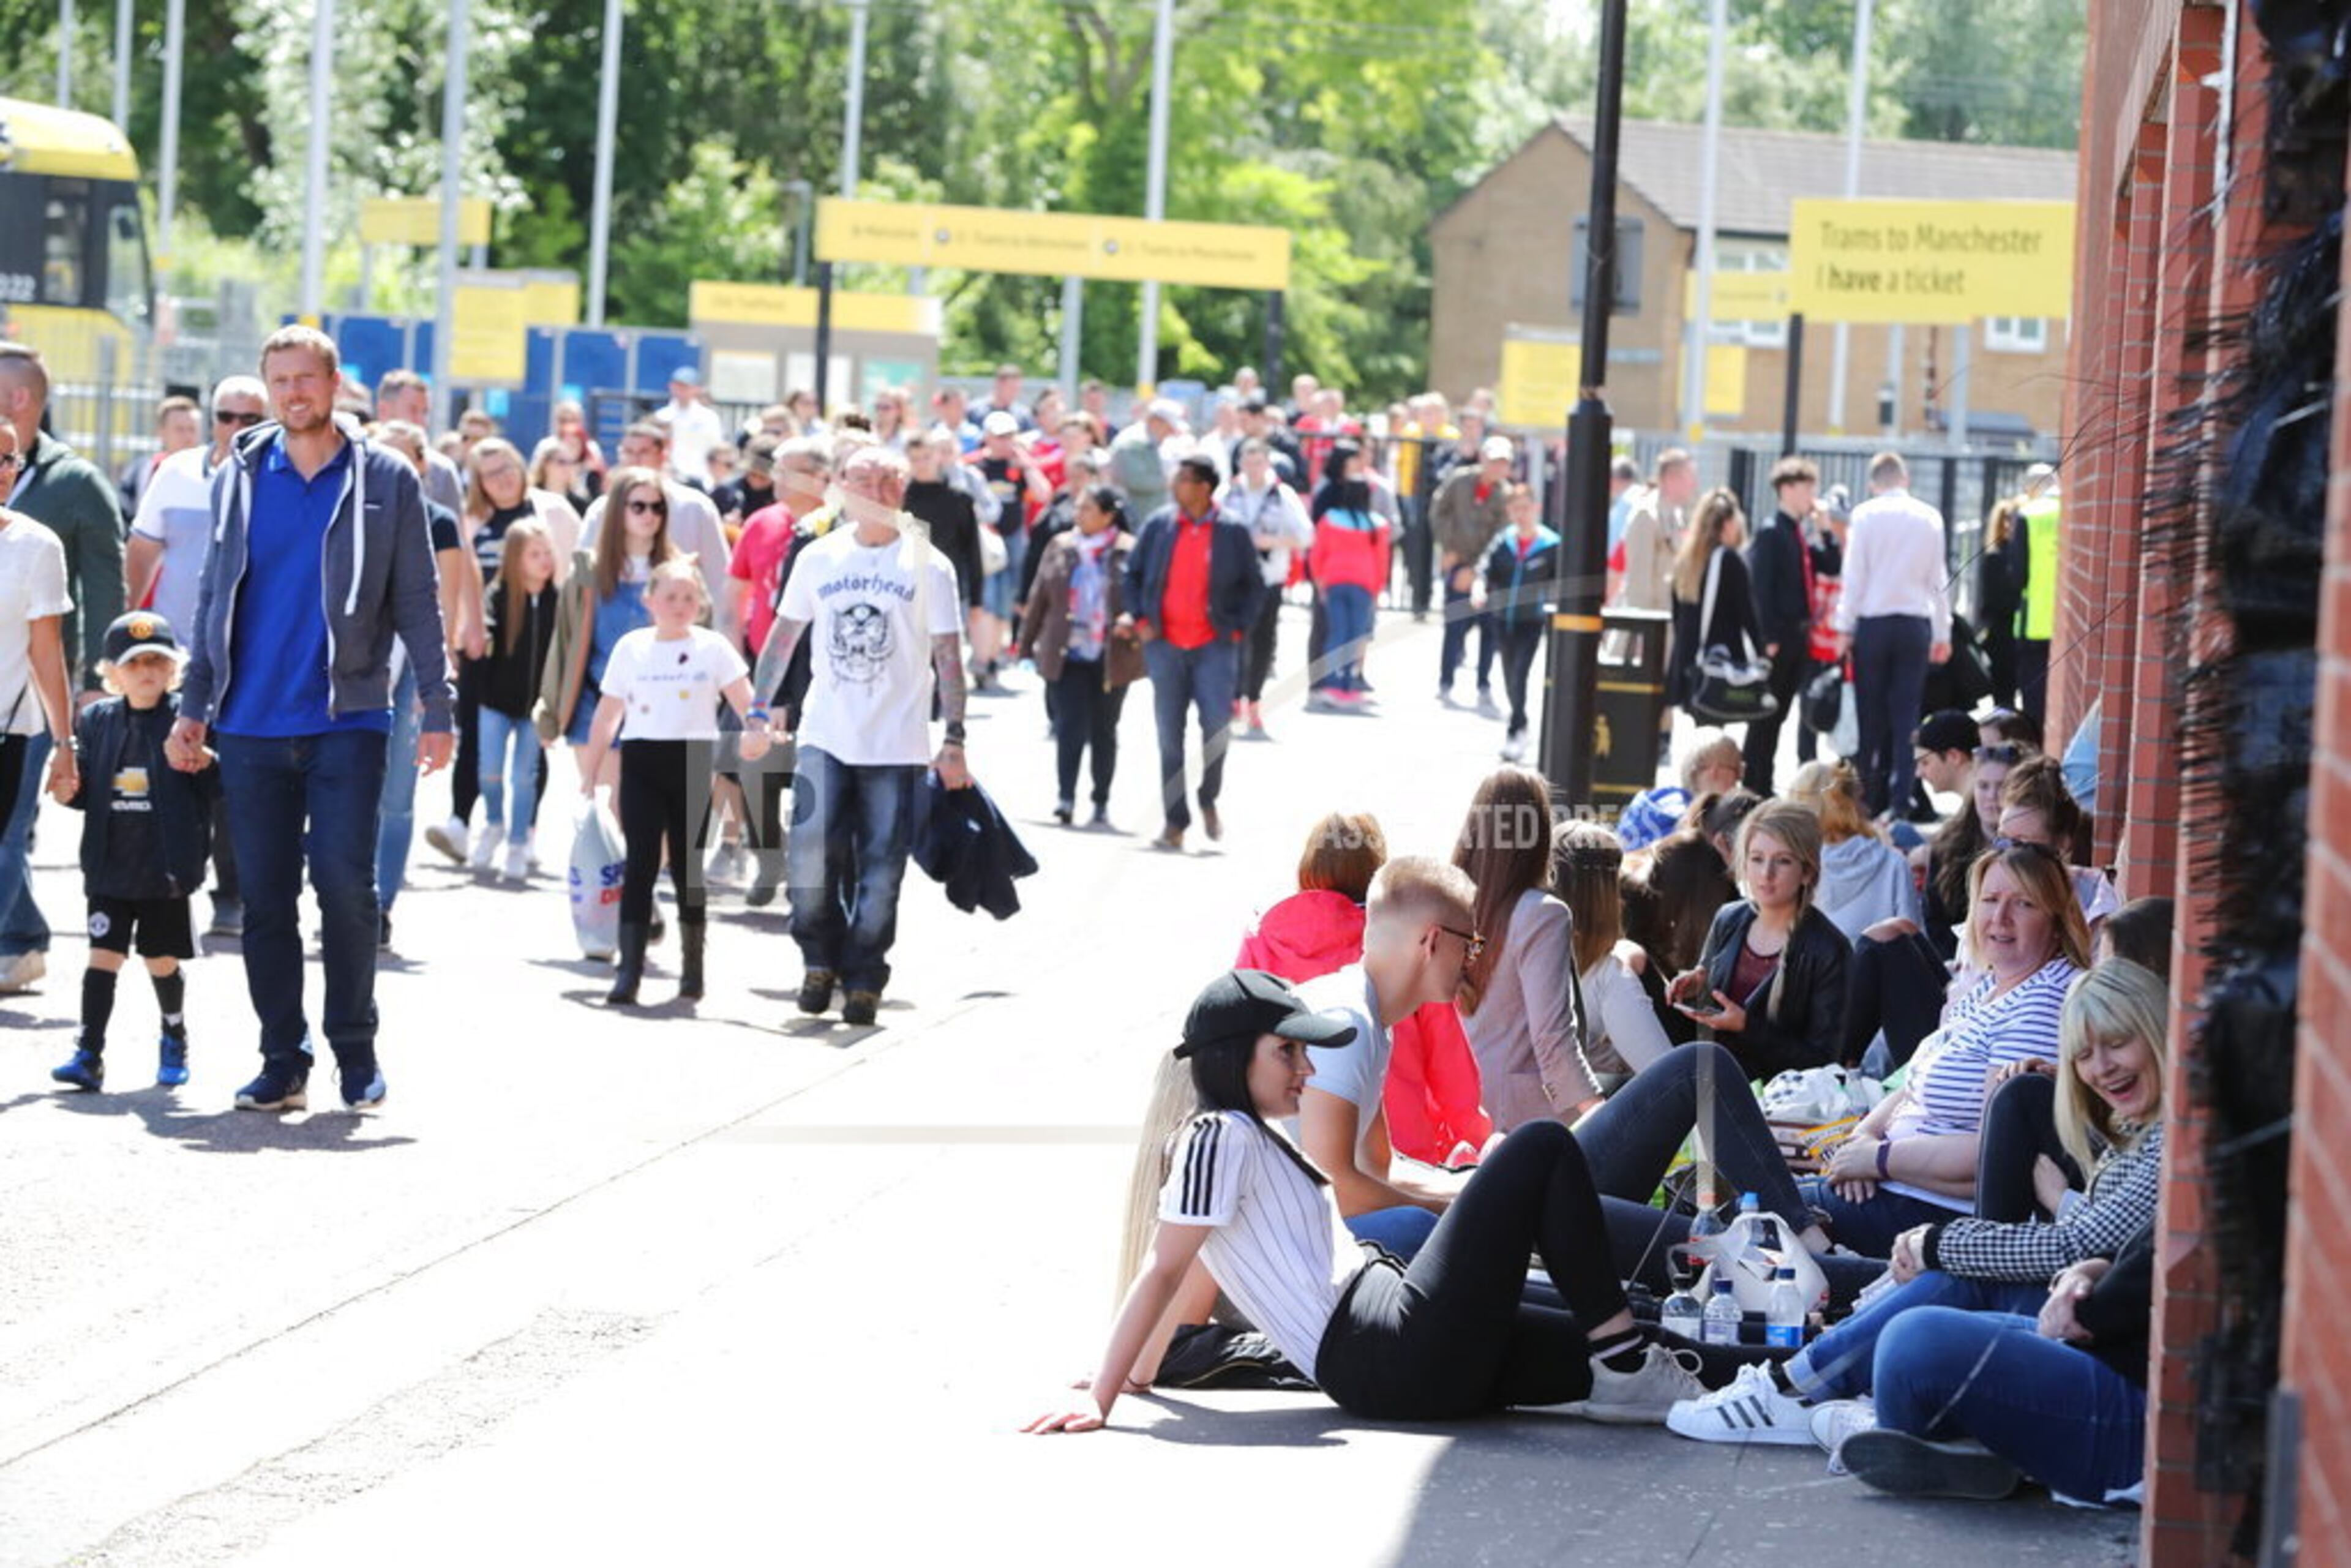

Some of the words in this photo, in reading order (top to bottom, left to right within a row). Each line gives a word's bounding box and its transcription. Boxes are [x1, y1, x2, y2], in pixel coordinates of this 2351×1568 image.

[1820, 222, 1881, 251] Trams
[1887, 225, 1910, 252] to
[1914, 223, 2042, 253] Manchester
[1827, 264, 1881, 292] have
[1886, 273, 1899, 293] a
[1904, 268, 1966, 294] ticket
